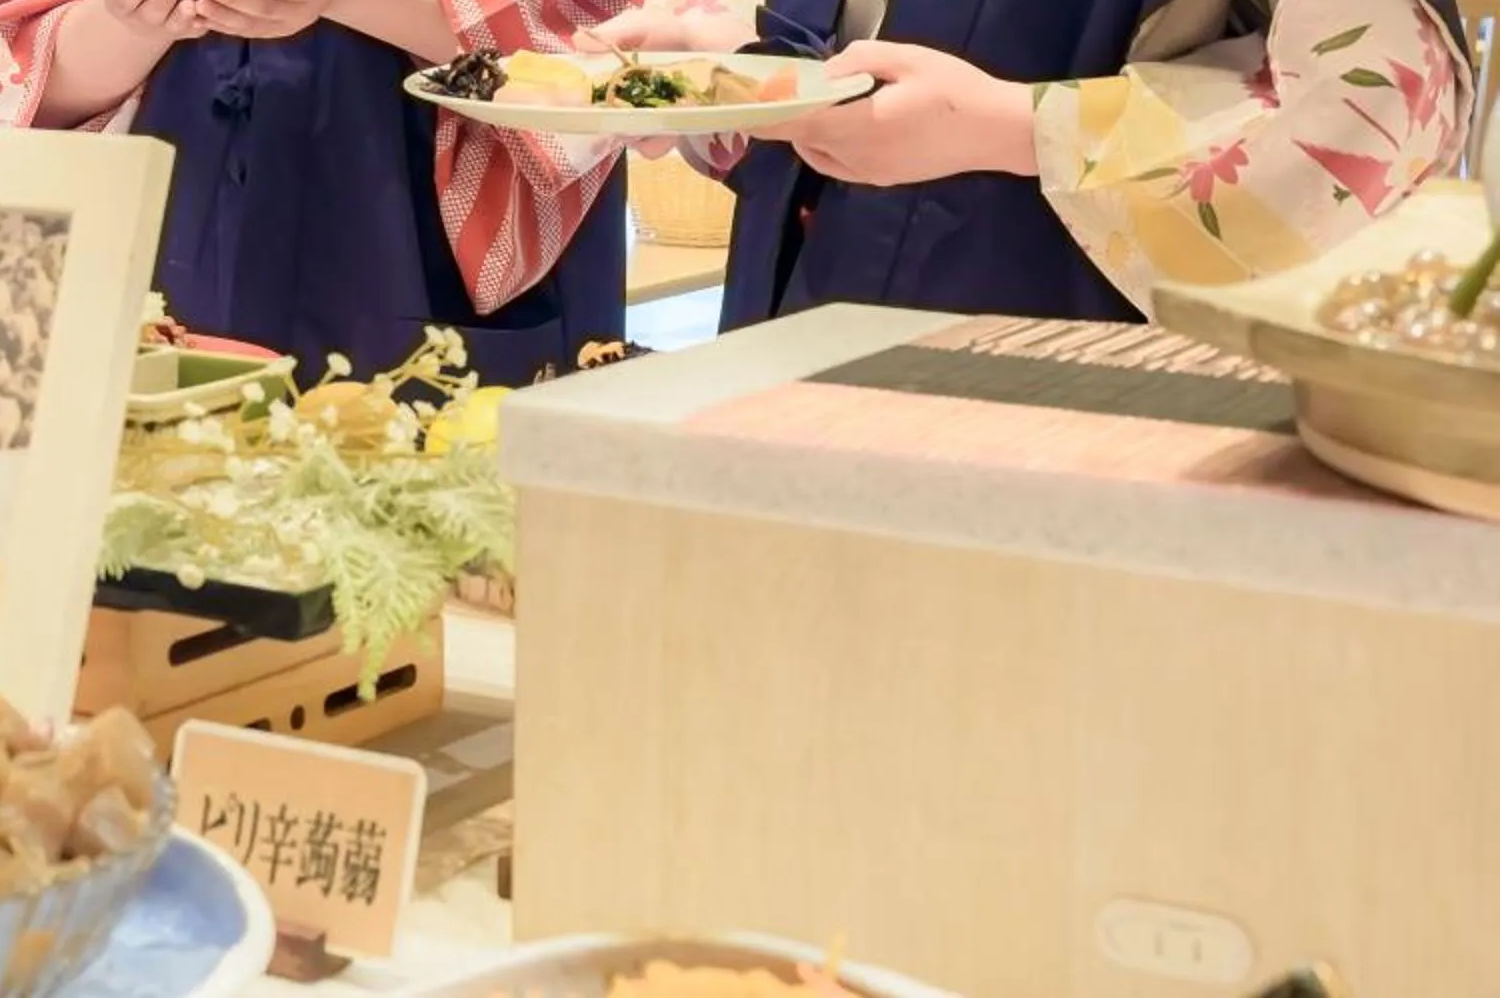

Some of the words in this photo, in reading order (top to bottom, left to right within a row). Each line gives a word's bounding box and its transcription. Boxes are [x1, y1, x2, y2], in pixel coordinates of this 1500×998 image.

[200, 791, 387, 906] ピリ辛蒟蒻
